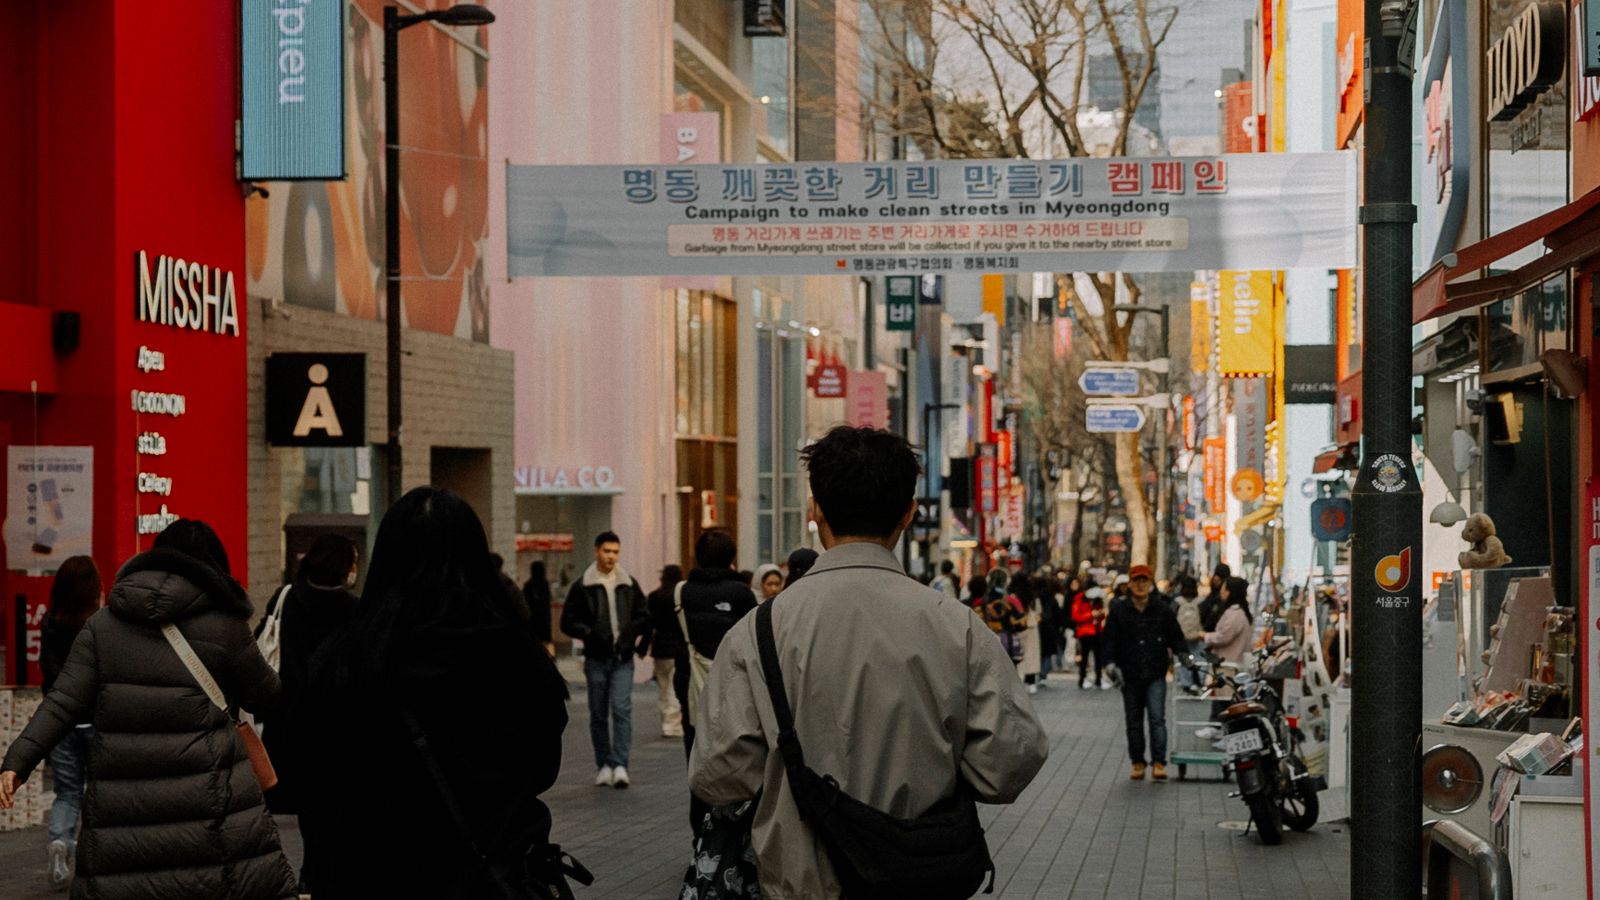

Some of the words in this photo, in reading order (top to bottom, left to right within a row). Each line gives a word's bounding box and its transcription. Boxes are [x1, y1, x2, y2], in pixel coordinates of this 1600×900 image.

[1486, 2, 1541, 122] LLOYD
[623, 168, 697, 202] 명동
[721, 167, 840, 201] 깨끗한
[863, 166, 937, 199] 거리
[964, 164, 1081, 197] 만들기
[1107, 160, 1226, 195] 캠페인
[685, 205, 779, 222] Campaign
[789, 206, 808, 217] to
[818, 204, 868, 217] make
[879, 204, 930, 216] clean
[940, 203, 1008, 216] streets
[1019, 201, 1035, 214] in
[1046, 200, 1169, 217] Myeongdong
[712, 227, 739, 241] 명동
[745, 226, 801, 240] 거리가게
[807, 225, 861, 240] 쓰레기는
[868, 225, 894, 239] 주변
[900, 224, 970, 239] 거리가게로
[978, 223, 1018, 238] 주시면
[1024, 222, 1080, 238] 수거하여
[1086, 221, 1143, 236] 드립니다
[684, 243, 728, 254] Garbage
[730, 243, 755, 252] from
[757, 242, 823, 254] Myeongdong
[826, 243, 857, 252] street
[860, 242, 885, 251] store
[888, 241, 906, 251] will
[908, 241, 921, 250] be
[924, 240, 971, 250] collected
[973, 240, 980, 250] if
[982, 242, 1001, 252] you
[1005, 240, 1027, 252] give
[1029, 239, 1036, 249] it
[1039, 239, 1050, 249] to
[1052, 239, 1070, 249] the
[1072, 239, 1107, 250] nearby
[1111, 238, 1142, 248] street
[1145, 238, 1172, 247] store
[139, 249, 240, 337] MISSHA
[578, 464, 614, 487] CO
[1375, 596, 1410, 608] 서울중구
